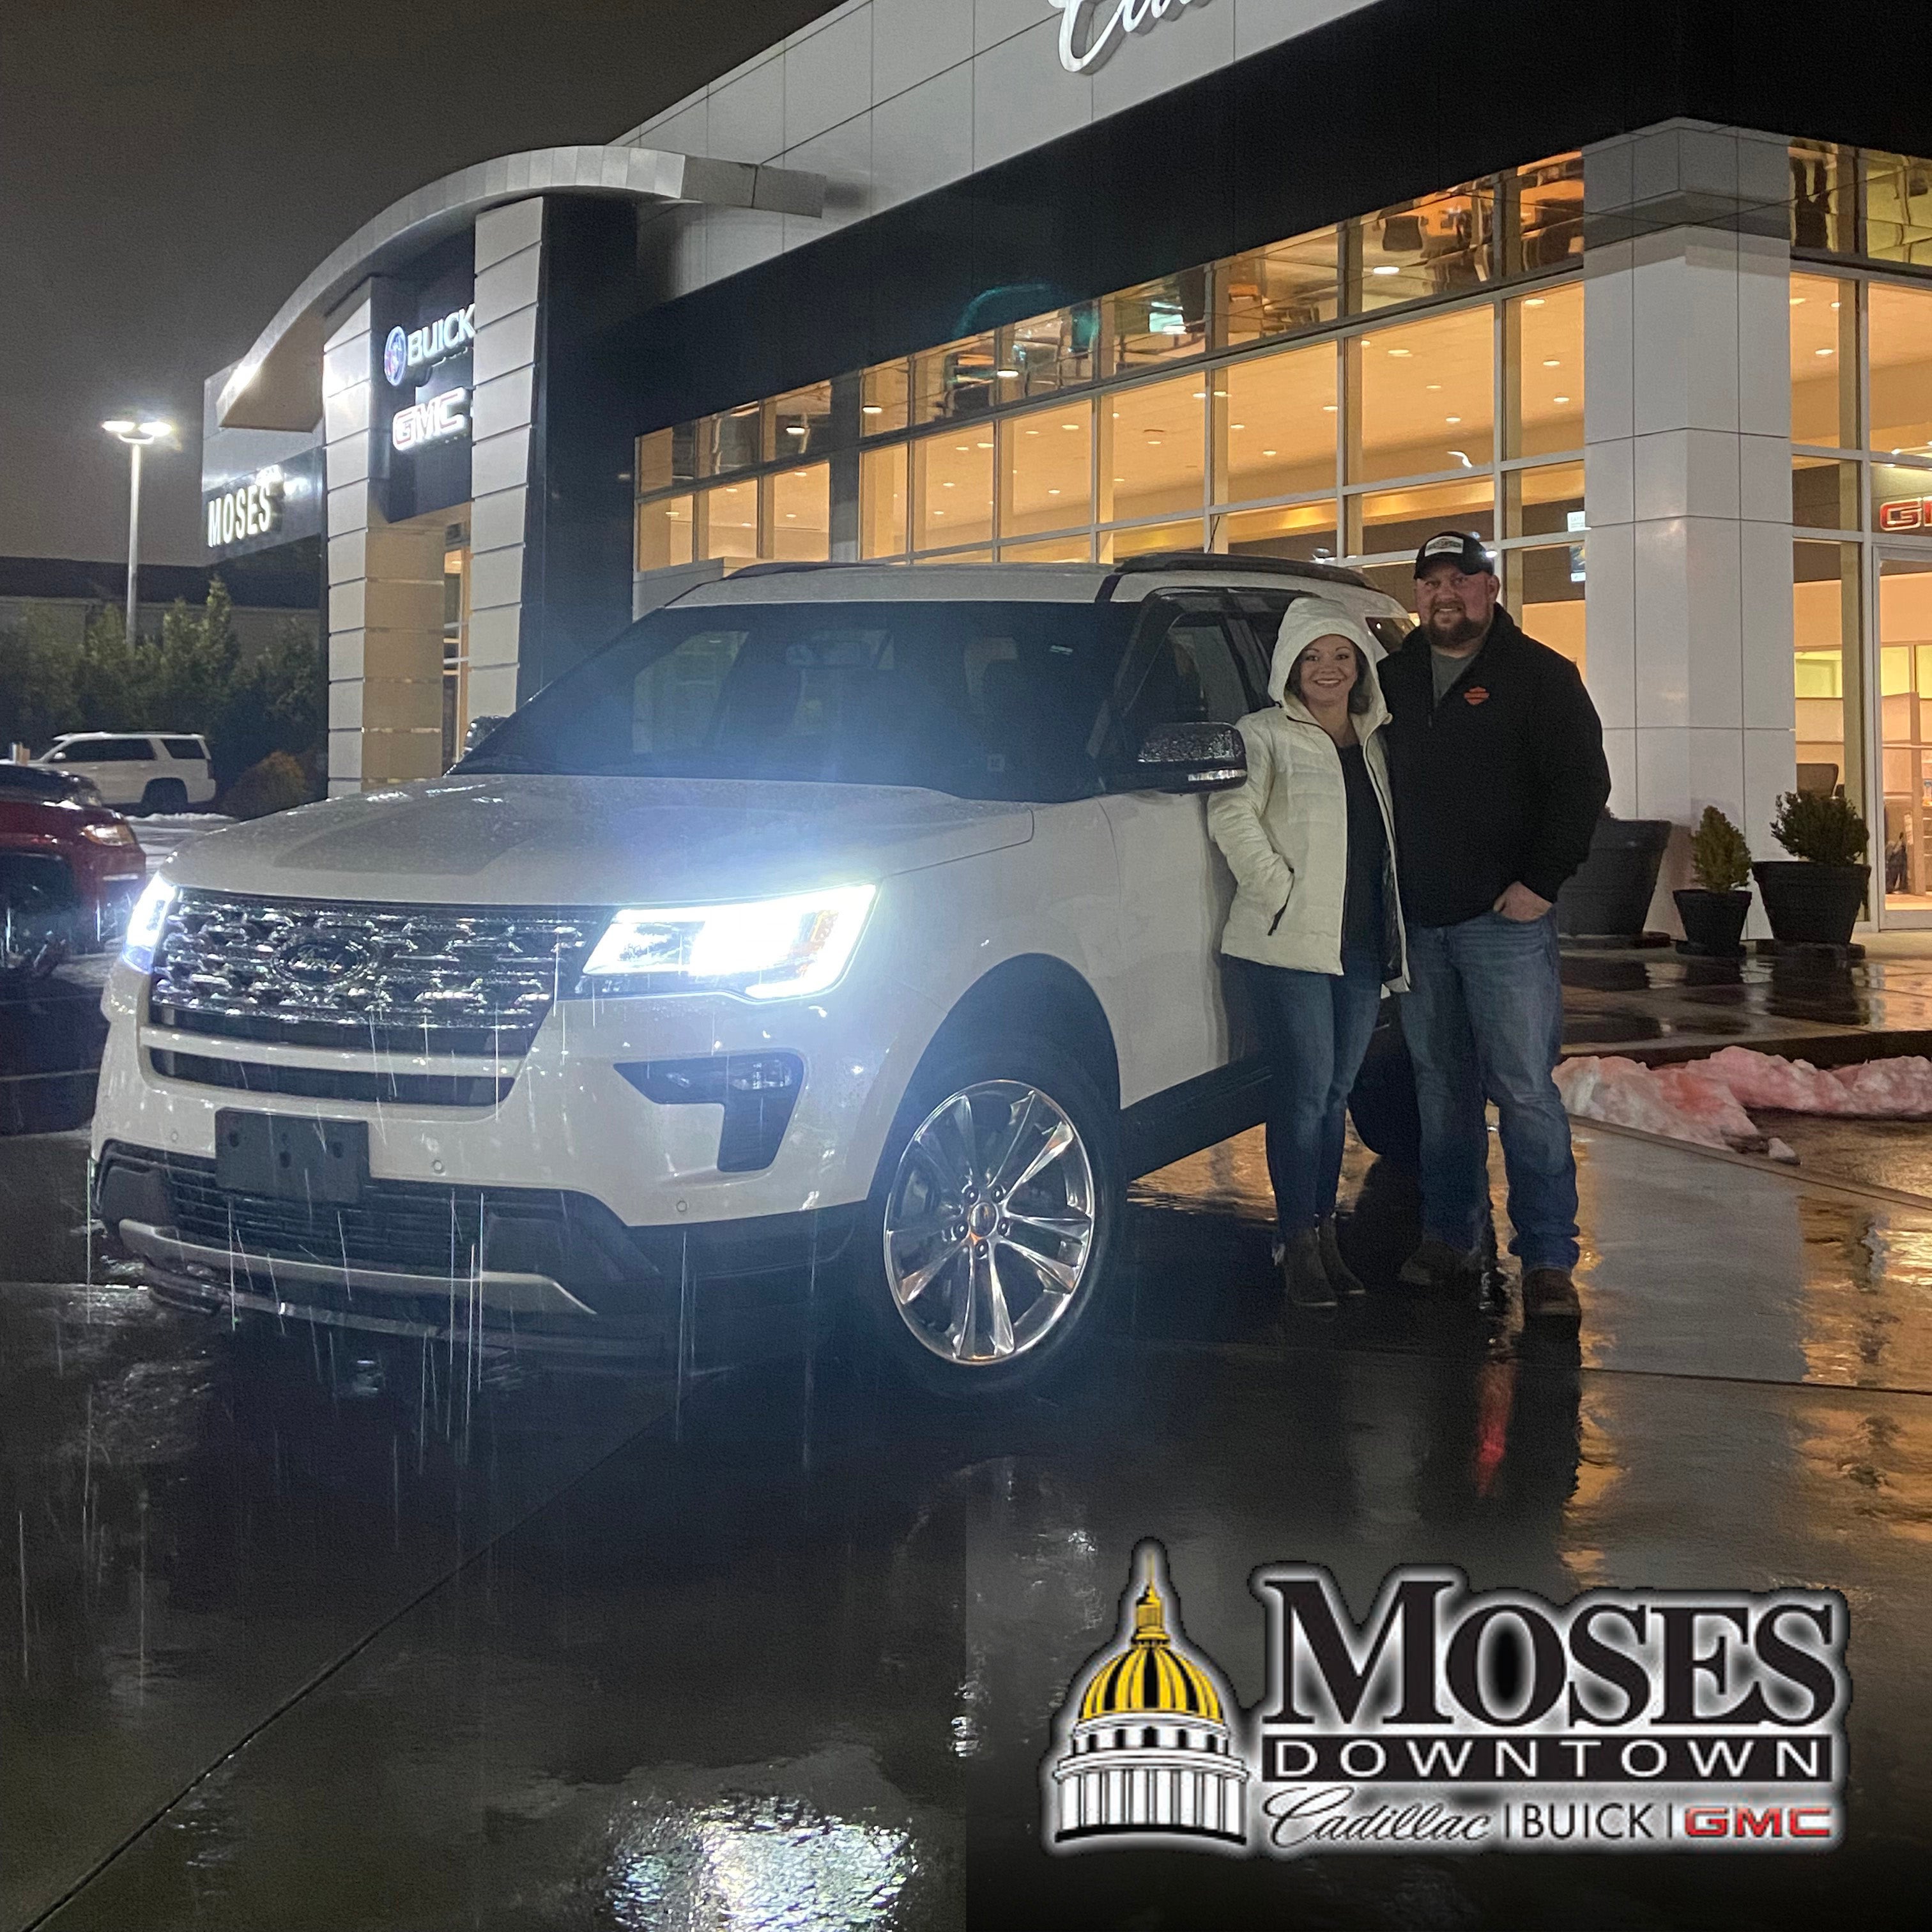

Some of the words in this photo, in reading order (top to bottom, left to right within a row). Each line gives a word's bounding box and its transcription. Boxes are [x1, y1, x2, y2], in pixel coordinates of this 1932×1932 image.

[407, 303, 476, 367] BUICK
[392, 387, 466, 451] GMC
[208, 484, 272, 548] MOSES
[1880, 495, 1932, 532] G
